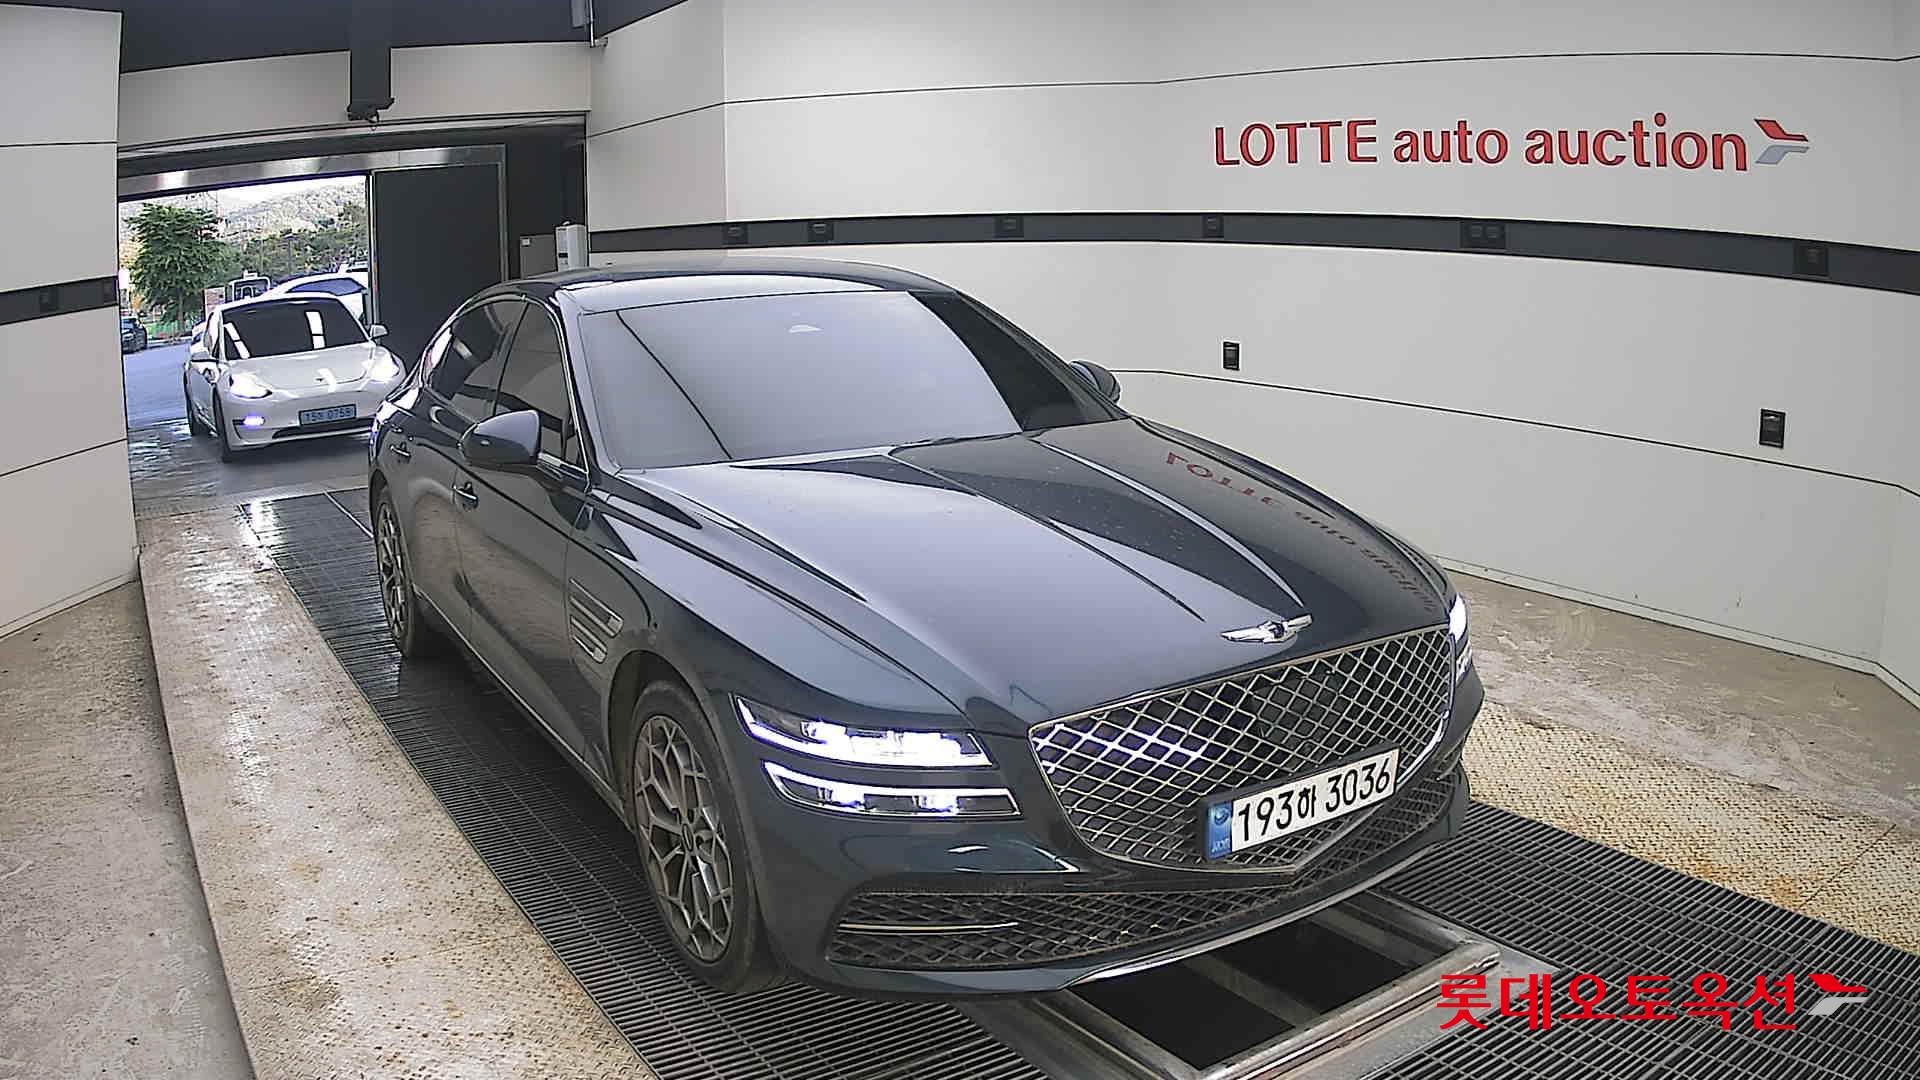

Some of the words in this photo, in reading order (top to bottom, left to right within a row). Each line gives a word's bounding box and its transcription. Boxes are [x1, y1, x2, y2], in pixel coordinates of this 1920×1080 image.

[1214, 118, 1377, 166] LOTTE
[1393, 120, 1508, 164] auto
[1525, 112, 1748, 172] auction
[1238, 785, 1317, 842] 193하
[1325, 757, 1391, 813] 3036
